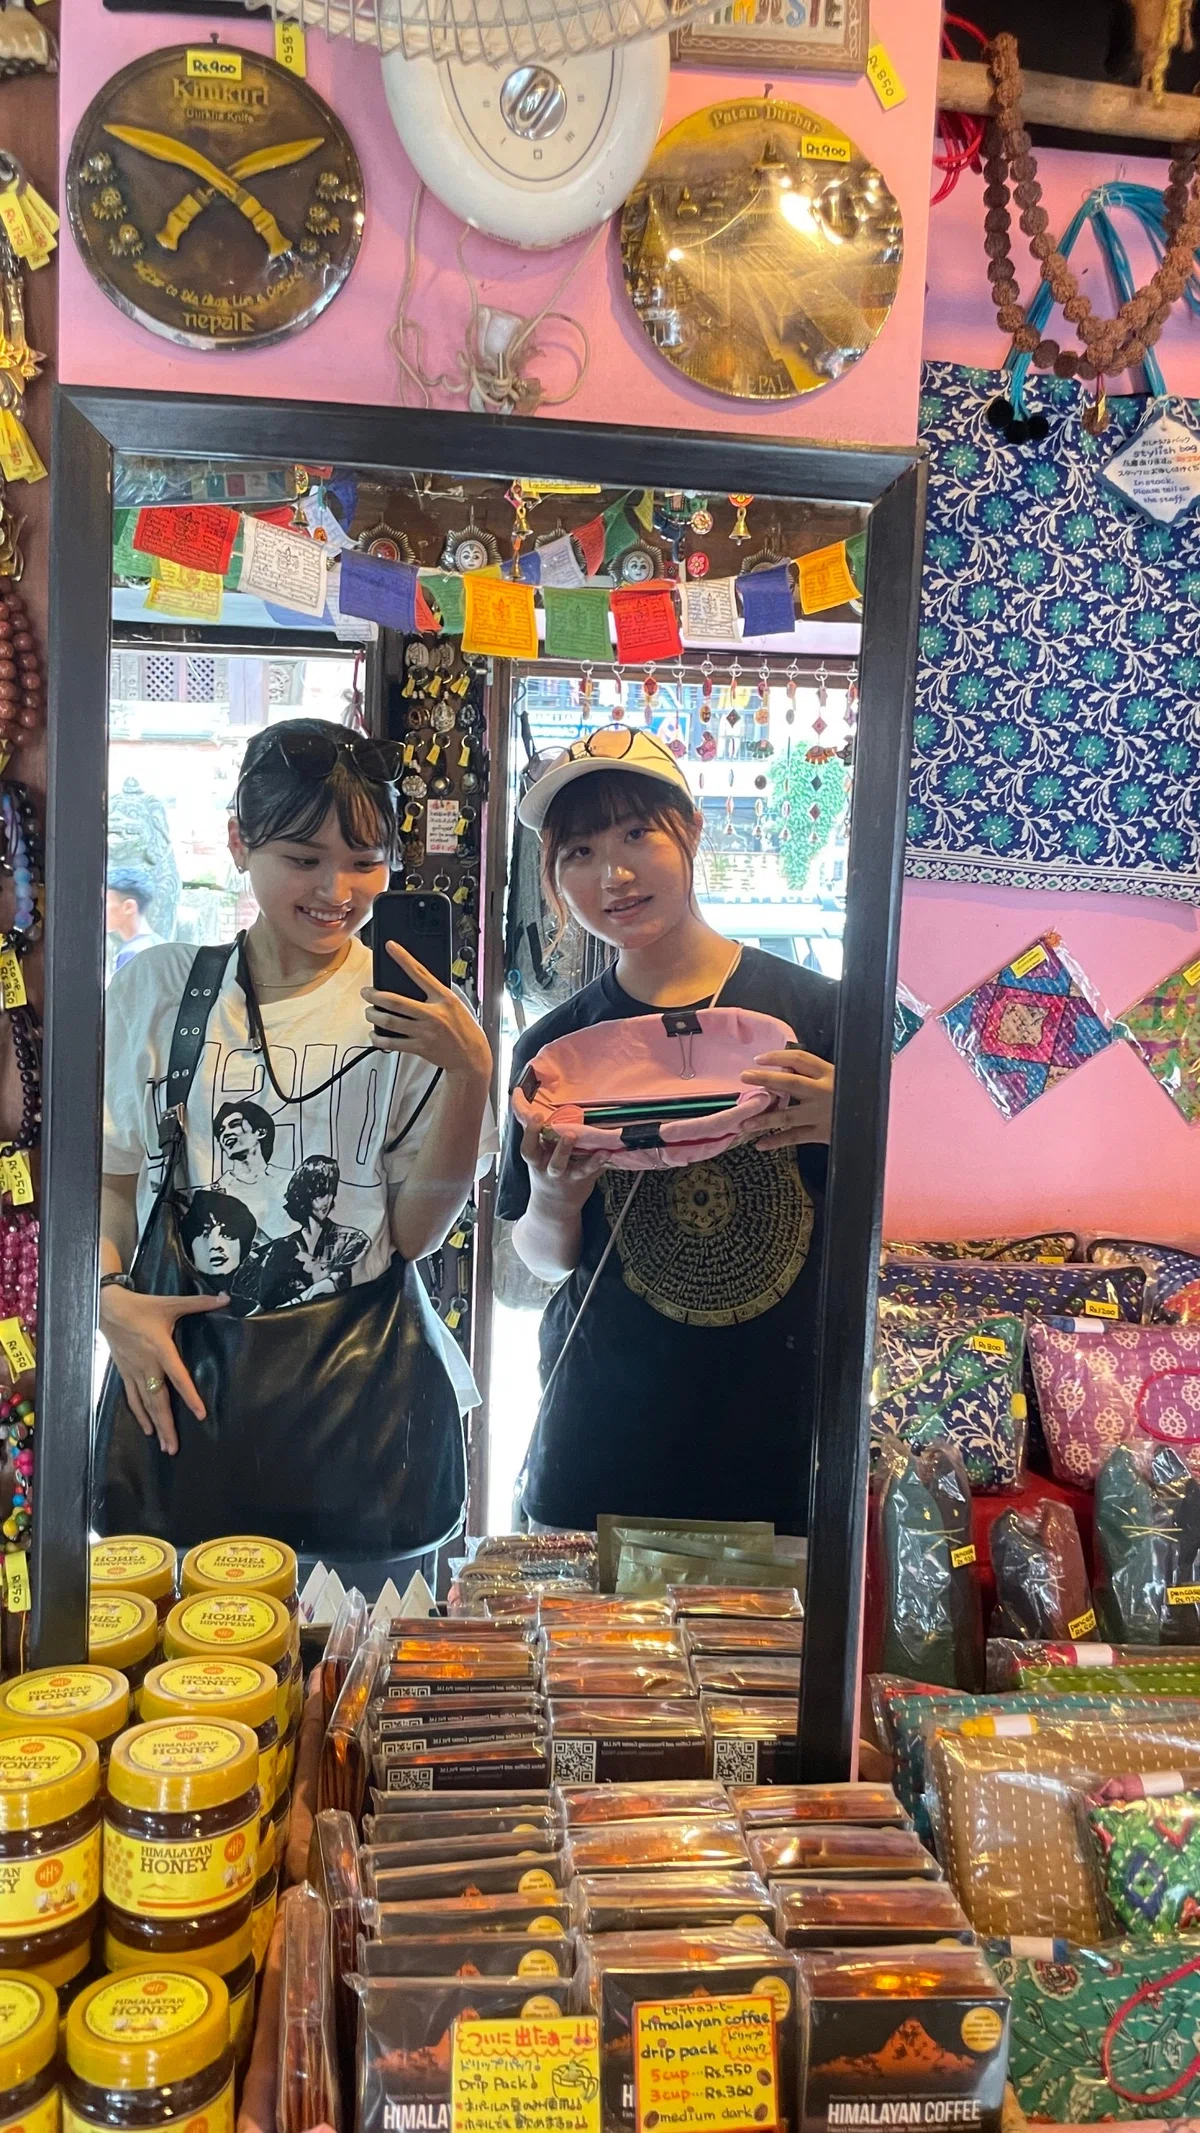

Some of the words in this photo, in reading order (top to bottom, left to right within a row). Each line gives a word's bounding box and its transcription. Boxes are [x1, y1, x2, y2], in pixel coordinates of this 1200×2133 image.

[712, 108, 759, 128] Patan
[765, 106, 822, 134] Durbar
[806, 143, 847, 157] Rs.900
[183, 312, 239, 334] nepal
[1133, 447, 1176, 458] stylish
[1179, 445, 1198, 454] bag
[180, 1679, 241, 1687] HONEY
[181, 1674, 242, 1682] HIMALAYAN
[28, 1685, 91, 1696] HIMALAYAN
[28, 1689, 91, 1702] HONEY
[152, 1745, 219, 1755] HONEY
[140, 1844, 213, 1858] HIMALAYAN
[140, 1856, 211, 1874] HONEY
[115, 1997, 185, 2006] HIMALAYAN
[110, 2005, 183, 2016] HONEY
[641, 2014, 722, 2032] Himalayan
[725, 2010, 770, 2025] coffee
[640, 2039, 675, 2063] drip
[679, 2040, 719, 2062] pack
[458, 2074, 488, 2093] Drip
[660, 2106, 716, 2124] medium
[721, 2104, 754, 2120] dark
[827, 2102, 920, 2124] HIMALAYAN
[925, 2099, 982, 2121] COFFEE
